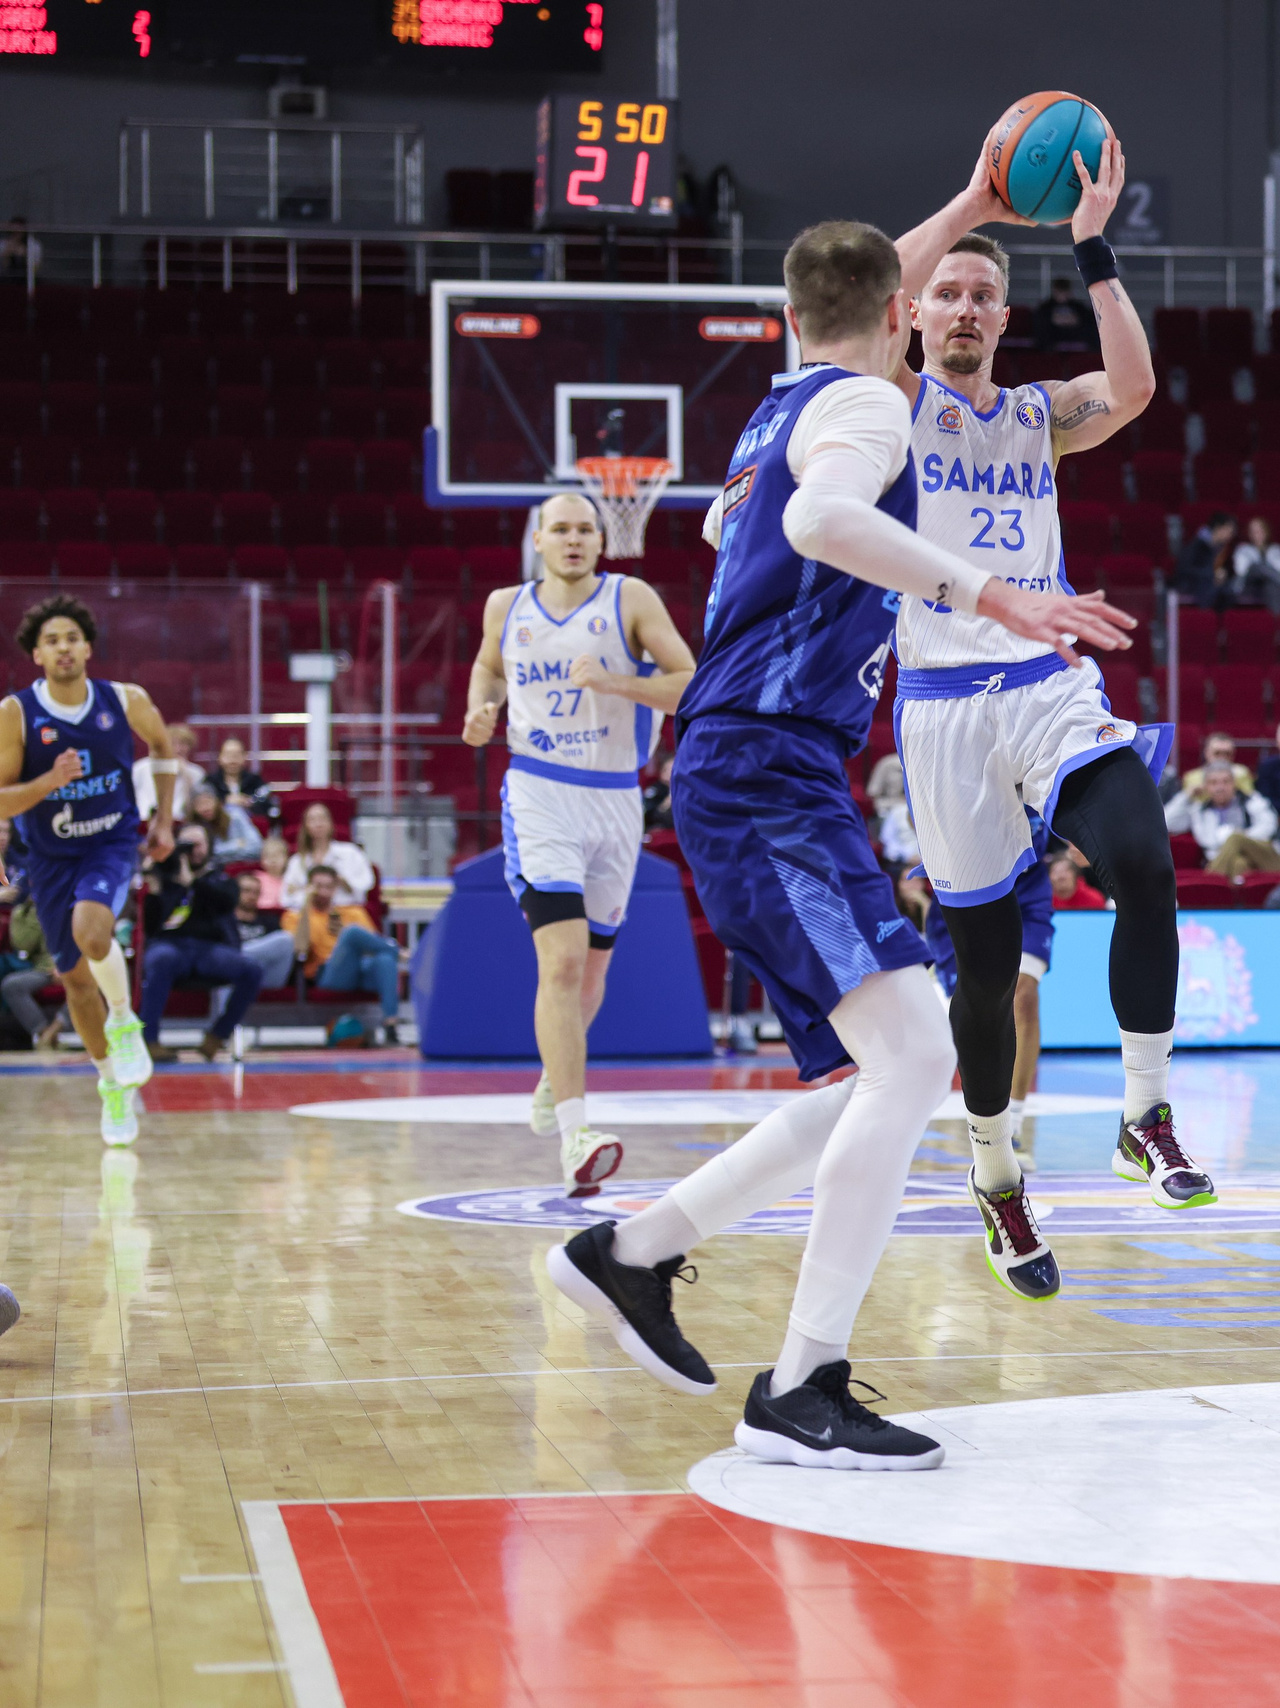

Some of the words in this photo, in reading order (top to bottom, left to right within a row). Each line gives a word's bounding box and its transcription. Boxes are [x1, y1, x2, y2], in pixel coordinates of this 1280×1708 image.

[577, 101, 603, 141] 5
[615, 103, 668, 144] 50
[566, 146, 649, 207] 21
[922, 453, 1053, 500] SAMARA
[969, 507, 1026, 552] 23
[546, 688, 583, 718] 27
